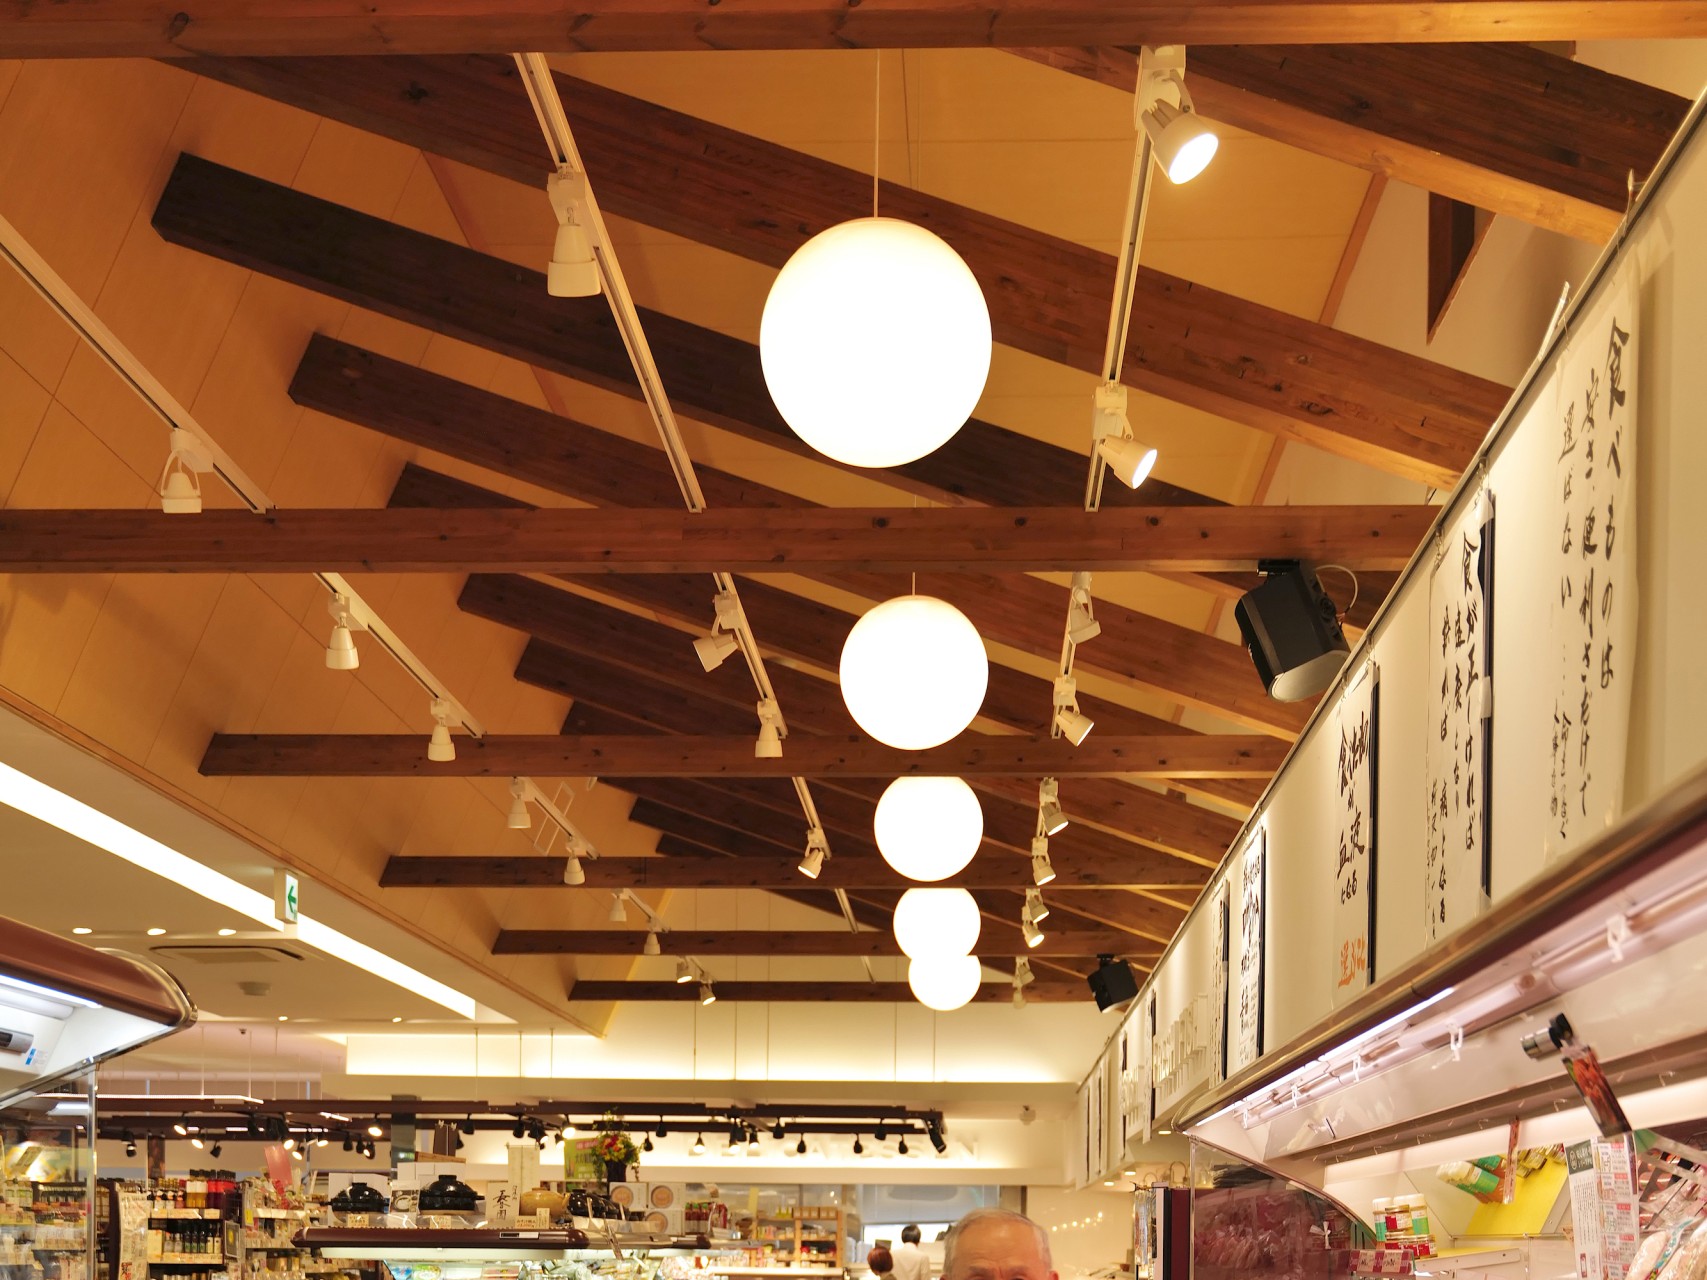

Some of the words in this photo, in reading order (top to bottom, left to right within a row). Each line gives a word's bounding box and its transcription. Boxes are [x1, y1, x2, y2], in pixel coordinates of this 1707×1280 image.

[1601, 316, 1630, 690] 食べものは
